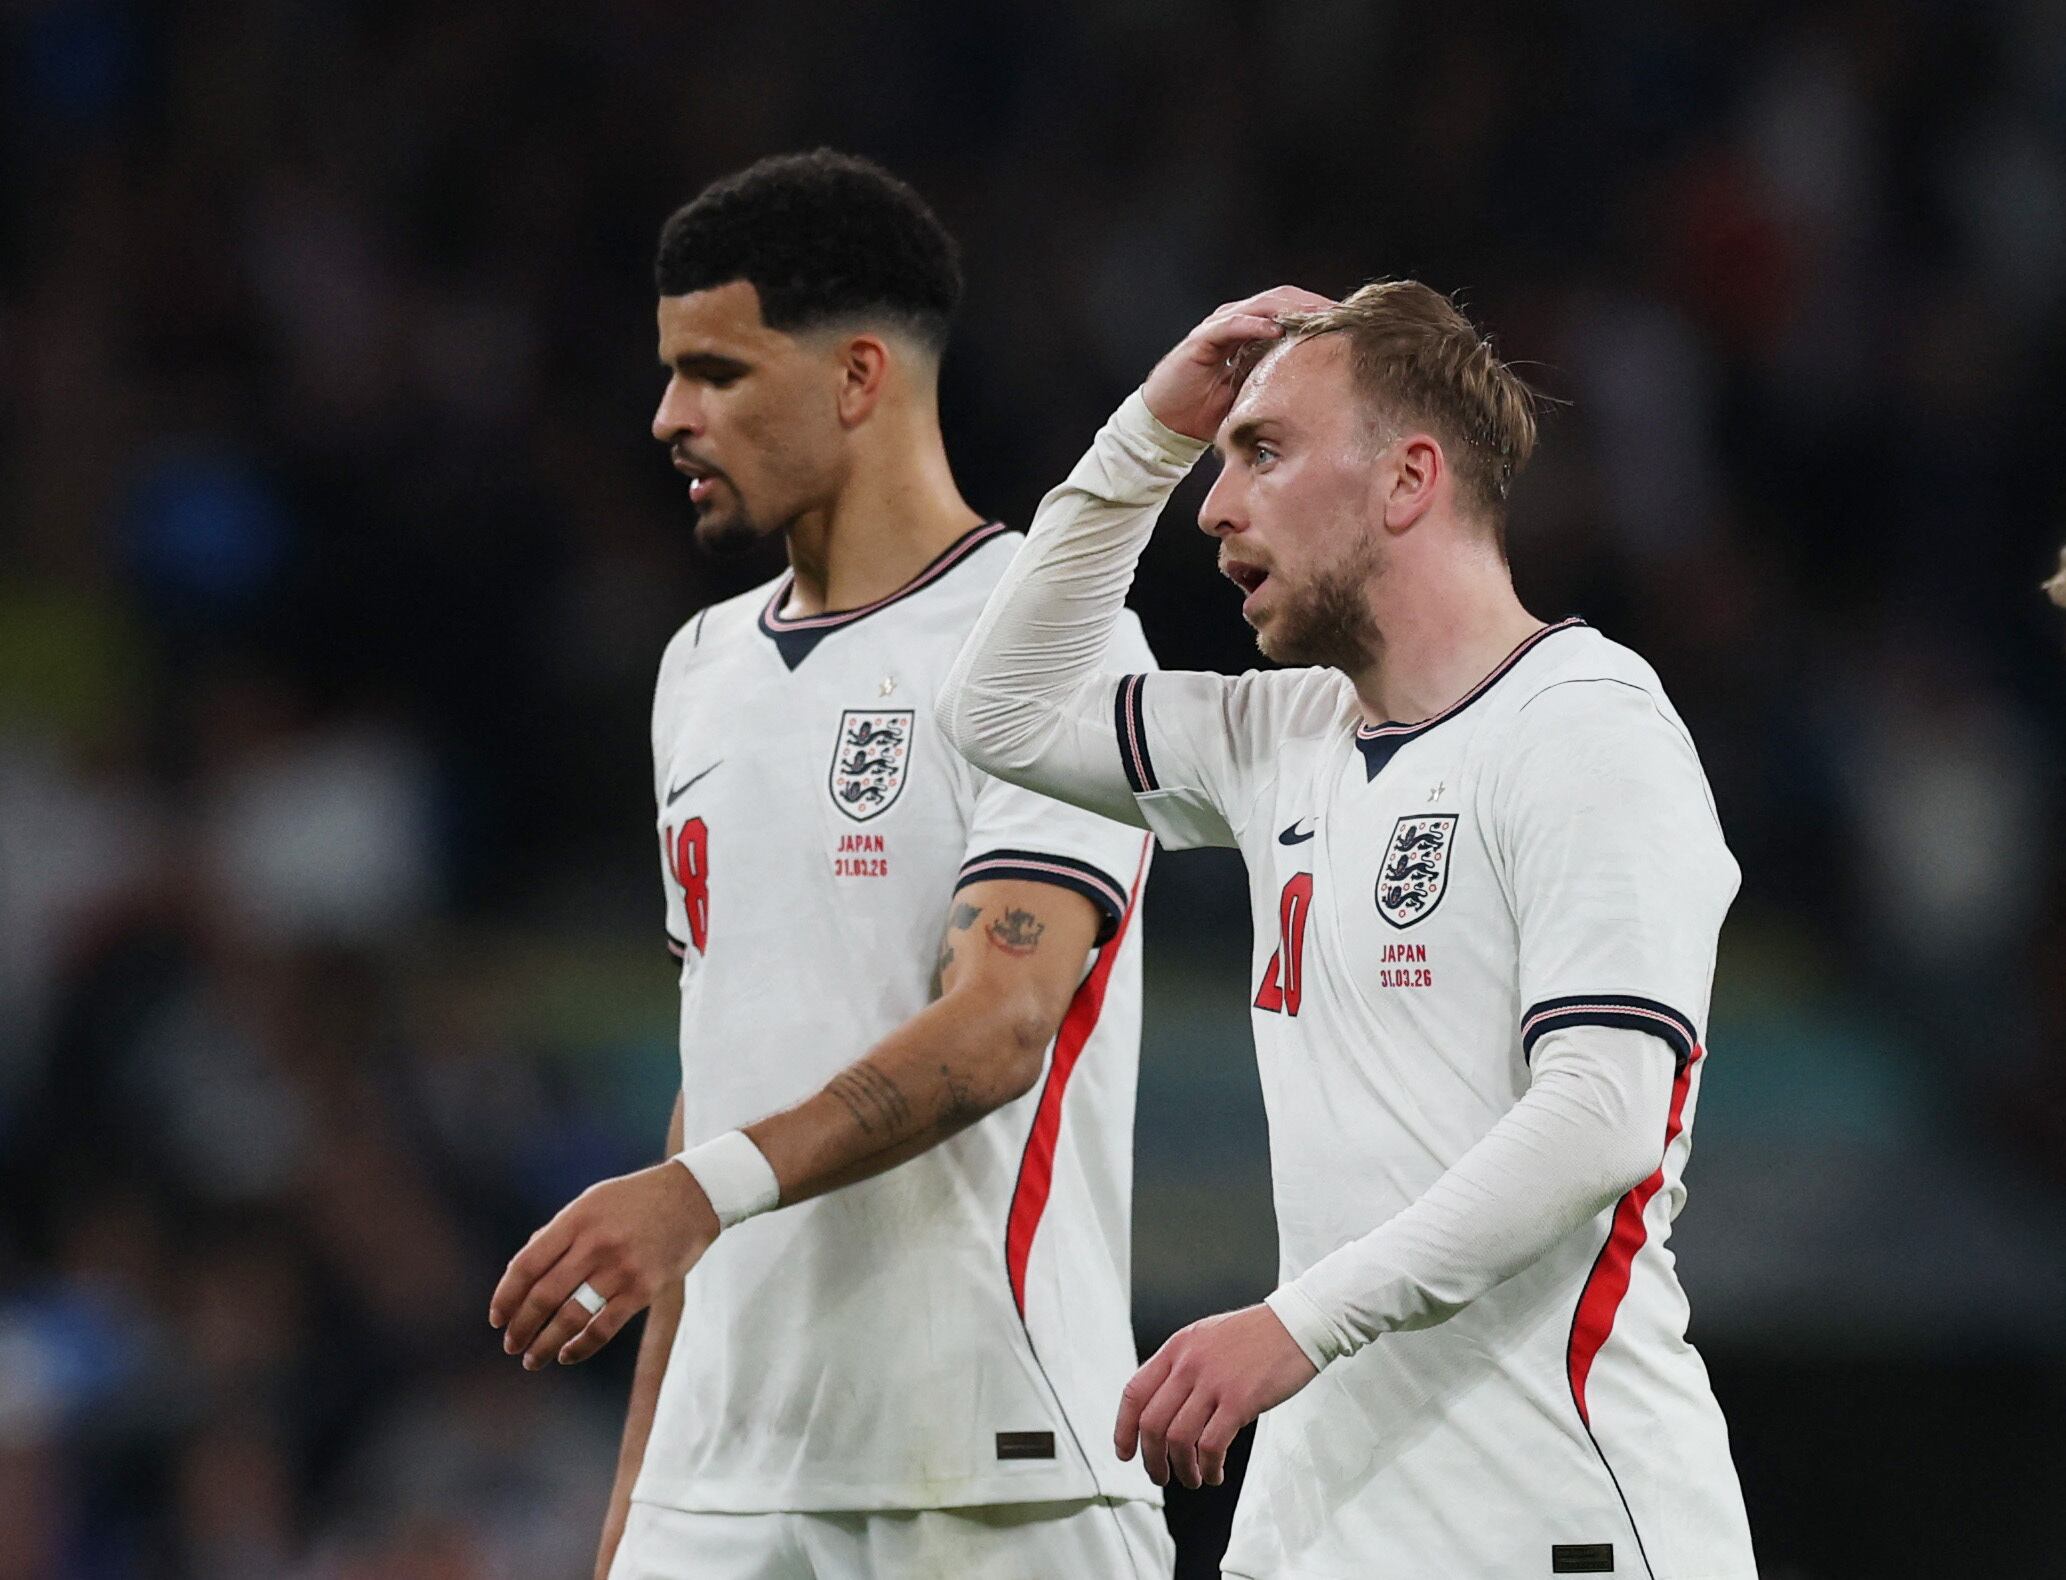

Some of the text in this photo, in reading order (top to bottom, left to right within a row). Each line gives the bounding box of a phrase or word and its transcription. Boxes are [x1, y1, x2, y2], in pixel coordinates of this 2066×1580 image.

[838, 834, 884, 852] JAPAN
[834, 858, 888, 877] 31.03.26
[1380, 944, 1426, 963] JAPAN
[1380, 968, 1432, 988] 31.03.26
